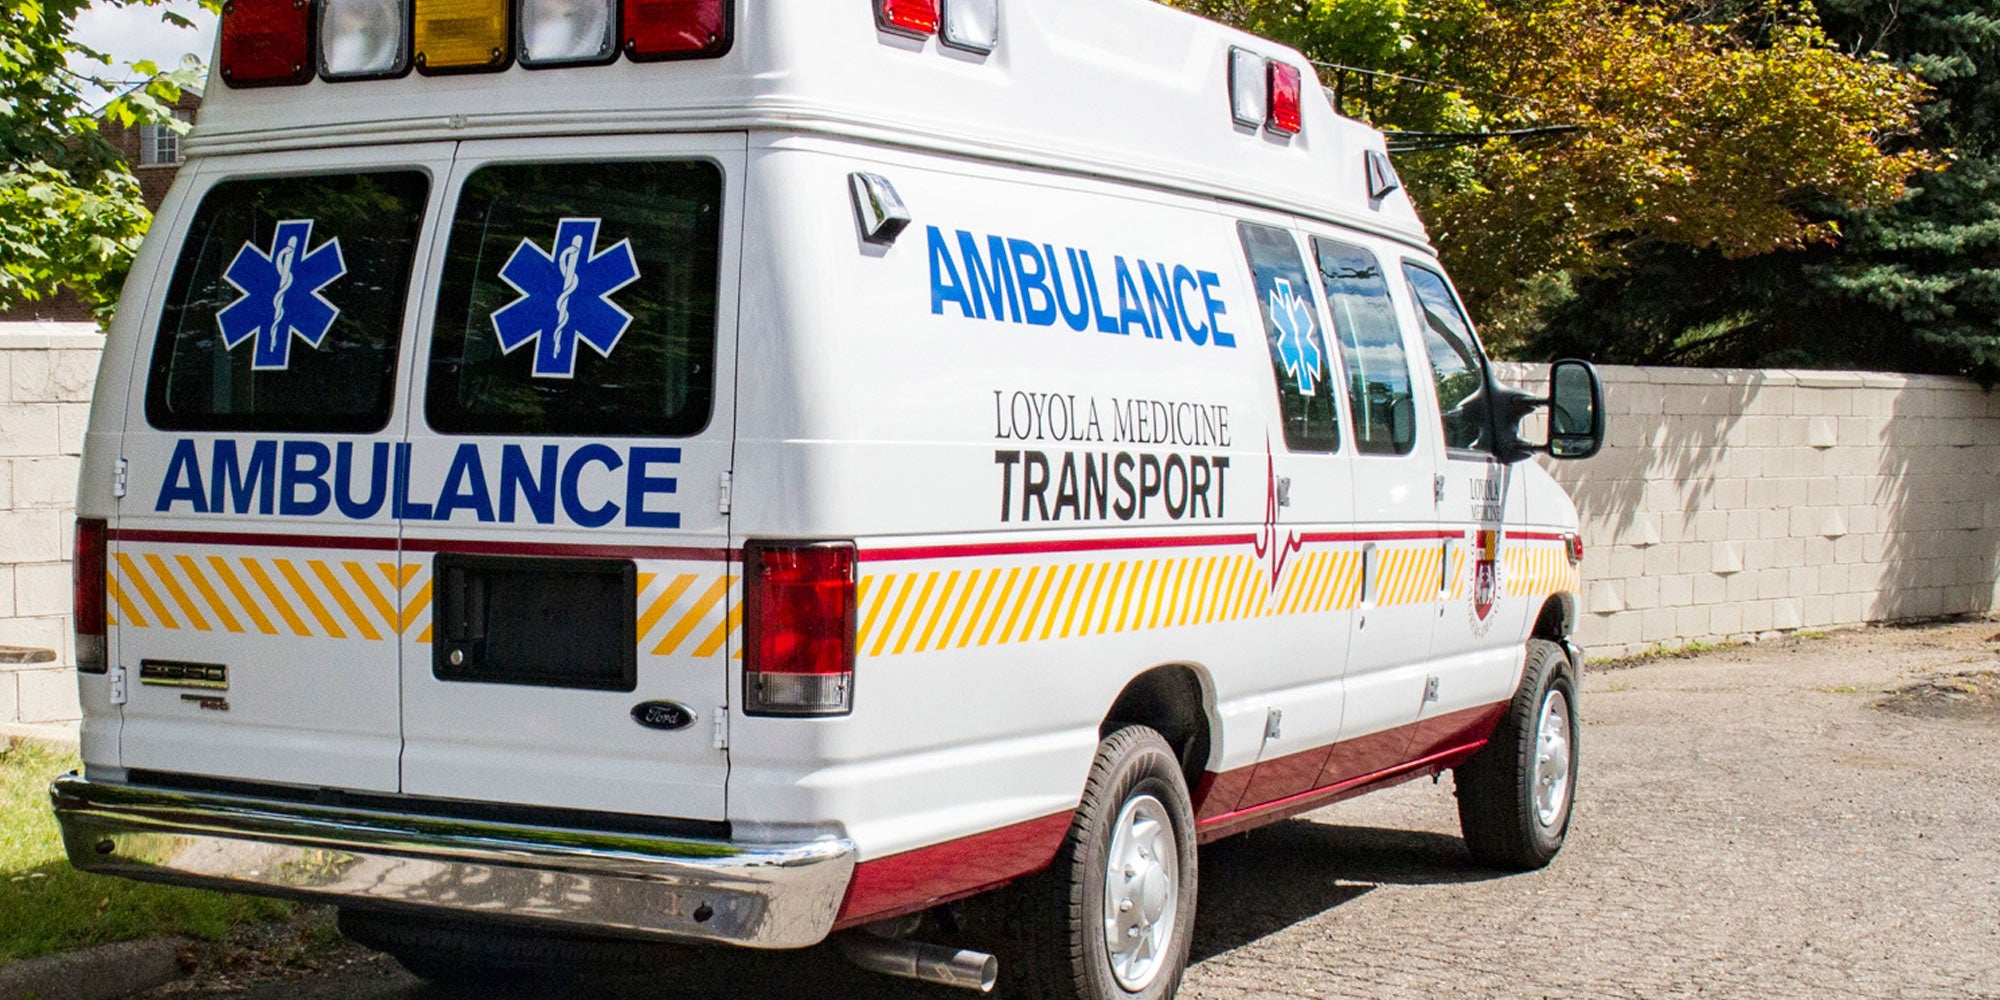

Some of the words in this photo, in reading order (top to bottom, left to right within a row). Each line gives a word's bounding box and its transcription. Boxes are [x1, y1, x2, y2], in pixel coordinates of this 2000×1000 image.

[926, 224, 1236, 348] AMBULANCE
[993, 390, 1104, 442] LOYOLA
[1112, 397, 1231, 447] MEDICINE
[155, 439, 682, 529] AMBULANCE
[994, 450, 1230, 523] TRANSPORT
[645, 706, 679, 724] Ford
